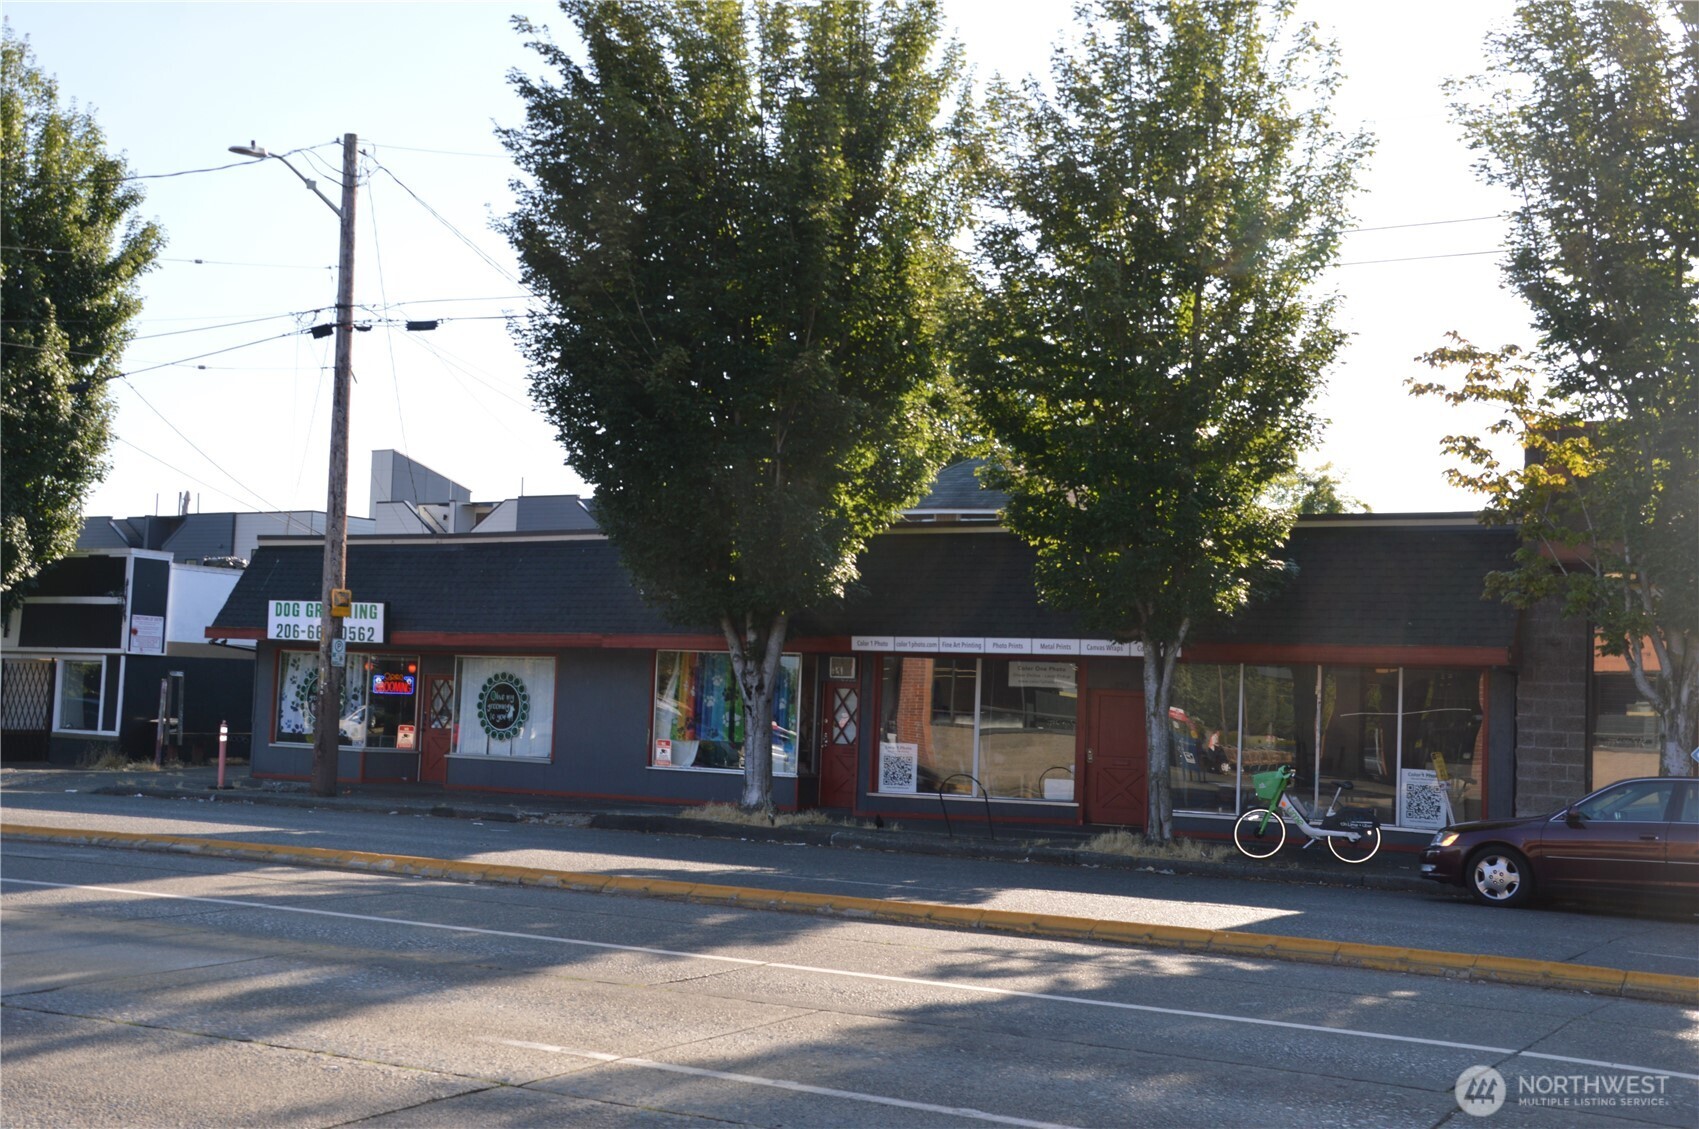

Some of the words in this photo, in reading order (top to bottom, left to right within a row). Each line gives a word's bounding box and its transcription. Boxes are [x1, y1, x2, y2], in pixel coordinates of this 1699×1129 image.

[275, 602, 300, 617] DOG
[305, 603, 378, 620] GRING
[276, 623, 375, 642] 206-660562
[857, 639, 869, 647] Color
[961, 641, 982, 650] Printing
[1106, 644, 1124, 653] Wraps
